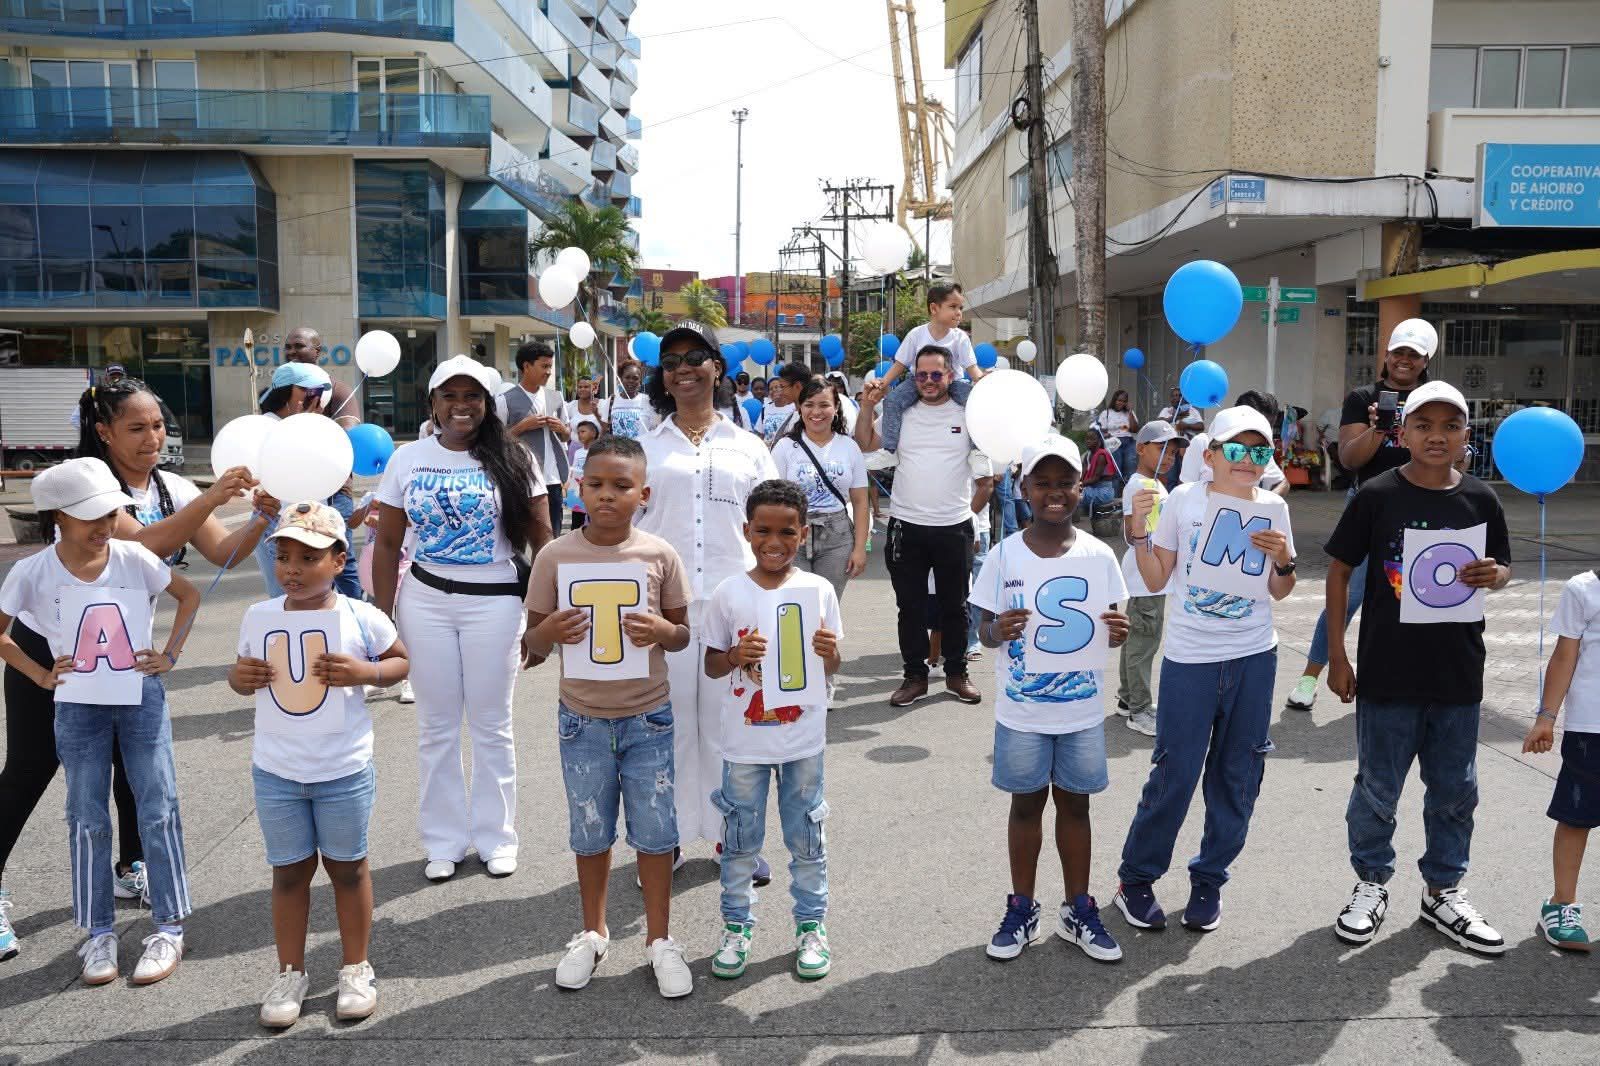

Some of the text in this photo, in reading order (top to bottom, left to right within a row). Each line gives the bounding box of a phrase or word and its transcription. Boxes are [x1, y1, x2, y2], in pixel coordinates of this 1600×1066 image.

[1510, 182, 1585, 195] DE AHORRO
[1510, 195, 1574, 211] Y CRÉDITO
[1511, 165, 1600, 177] COOPERATIVA
[411, 467, 452, 475] CAMINANDO
[1201, 507, 1272, 576] M
[1408, 542, 1479, 608] O
[71, 603, 138, 673] A
[569, 578, 640, 664] T
[776, 603, 807, 692] I
[1034, 576, 1095, 654] S
[263, 629, 330, 716] U
